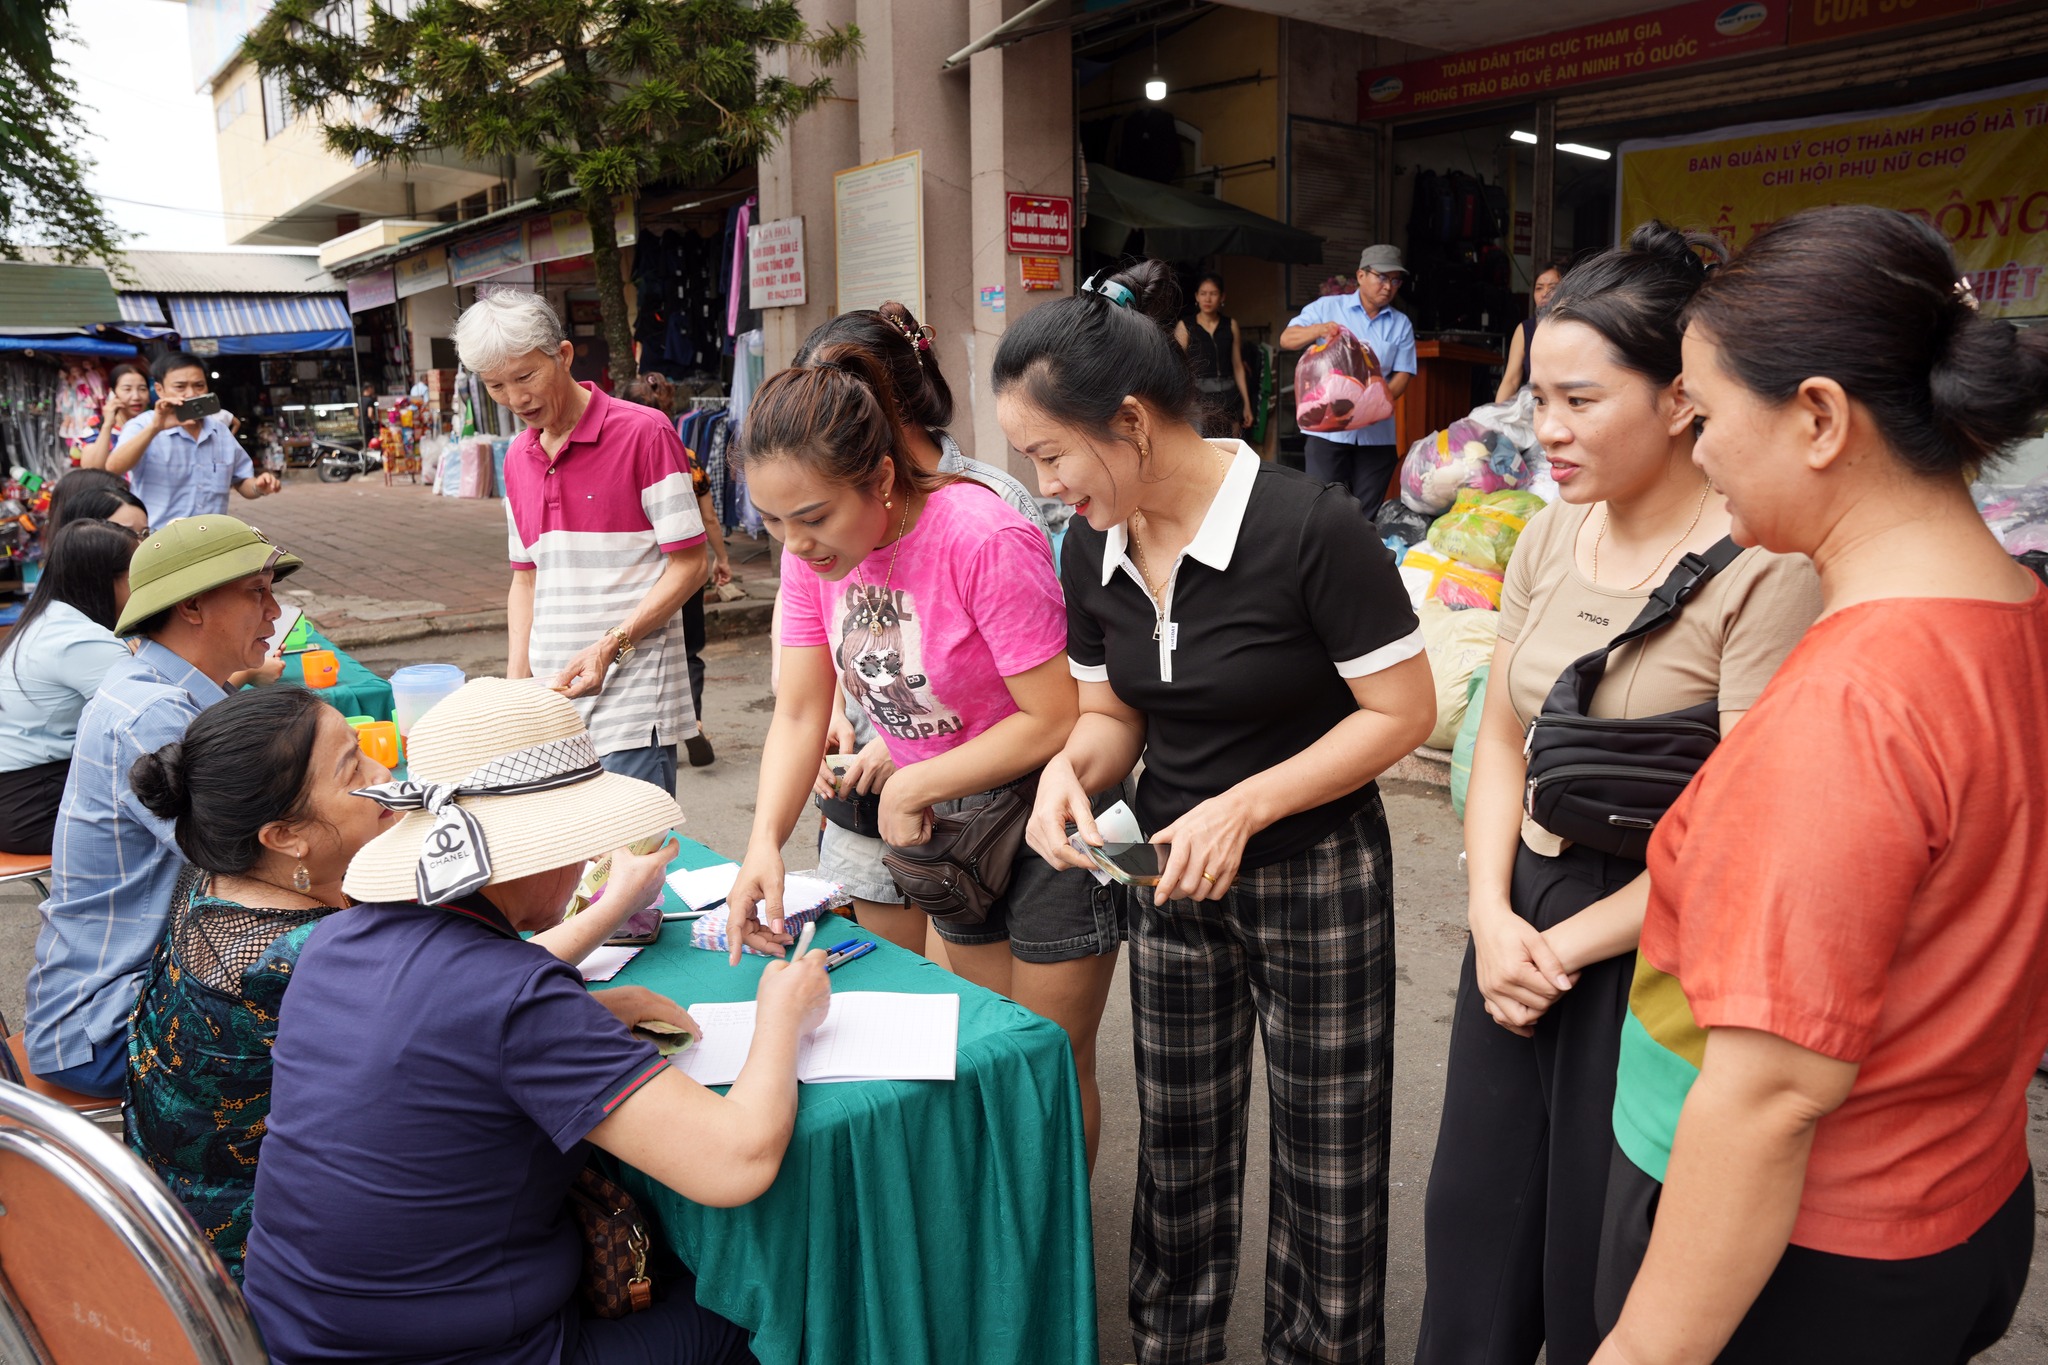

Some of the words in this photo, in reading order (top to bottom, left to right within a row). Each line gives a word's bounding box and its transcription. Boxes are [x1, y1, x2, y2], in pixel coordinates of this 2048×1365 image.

[1413, 86, 1458, 105] PHONG
[1462, 78, 1497, 97] TRÀO
[1500, 69, 1529, 91] BẢO
[1534, 64, 1552, 87] VỆ
[1556, 63, 1578, 81] AN
[1582, 55, 1619, 76] NINH
[1624, 42, 1645, 68] TỔ
[1649, 35, 1698, 64] QUỐC
[1441, 57, 1477, 78] TOÀN
[1480, 52, 1510, 72] DÂN
[1514, 45, 1545, 64] TÍCH
[1549, 38, 1580, 60] CỰC
[1584, 28, 1629, 51] THAM
[1633, 21, 1662, 41] GIA
[1688, 154, 1722, 172] BAN
[1727, 145, 1777, 168] QUẢN
[1783, 141, 1802, 161] LÝ
[1807, 136, 1851, 158] CHỢ
[1856, 128, 1924, 152] THÀNH
[1931, 112, 1977, 139] PHỐ
[1983, 107, 2016, 132] HÀ
[1762, 170, 1794, 187] CHI
[1800, 162, 1833, 185] HỘI
[1839, 158, 1876, 179] PHỤ
[1883, 150, 1913, 172] NỮ
[1917, 144, 1967, 168] CHỢ
[1012, 207, 1025, 227] CẤM
[1026, 210, 1038, 228] HÚT
[1039, 210, 1059, 229] THUỐC
[1059, 212, 1067, 229] LÁ
[1577, 611, 1610, 627] ATMOS
[429, 851, 469, 869] CHANEL
